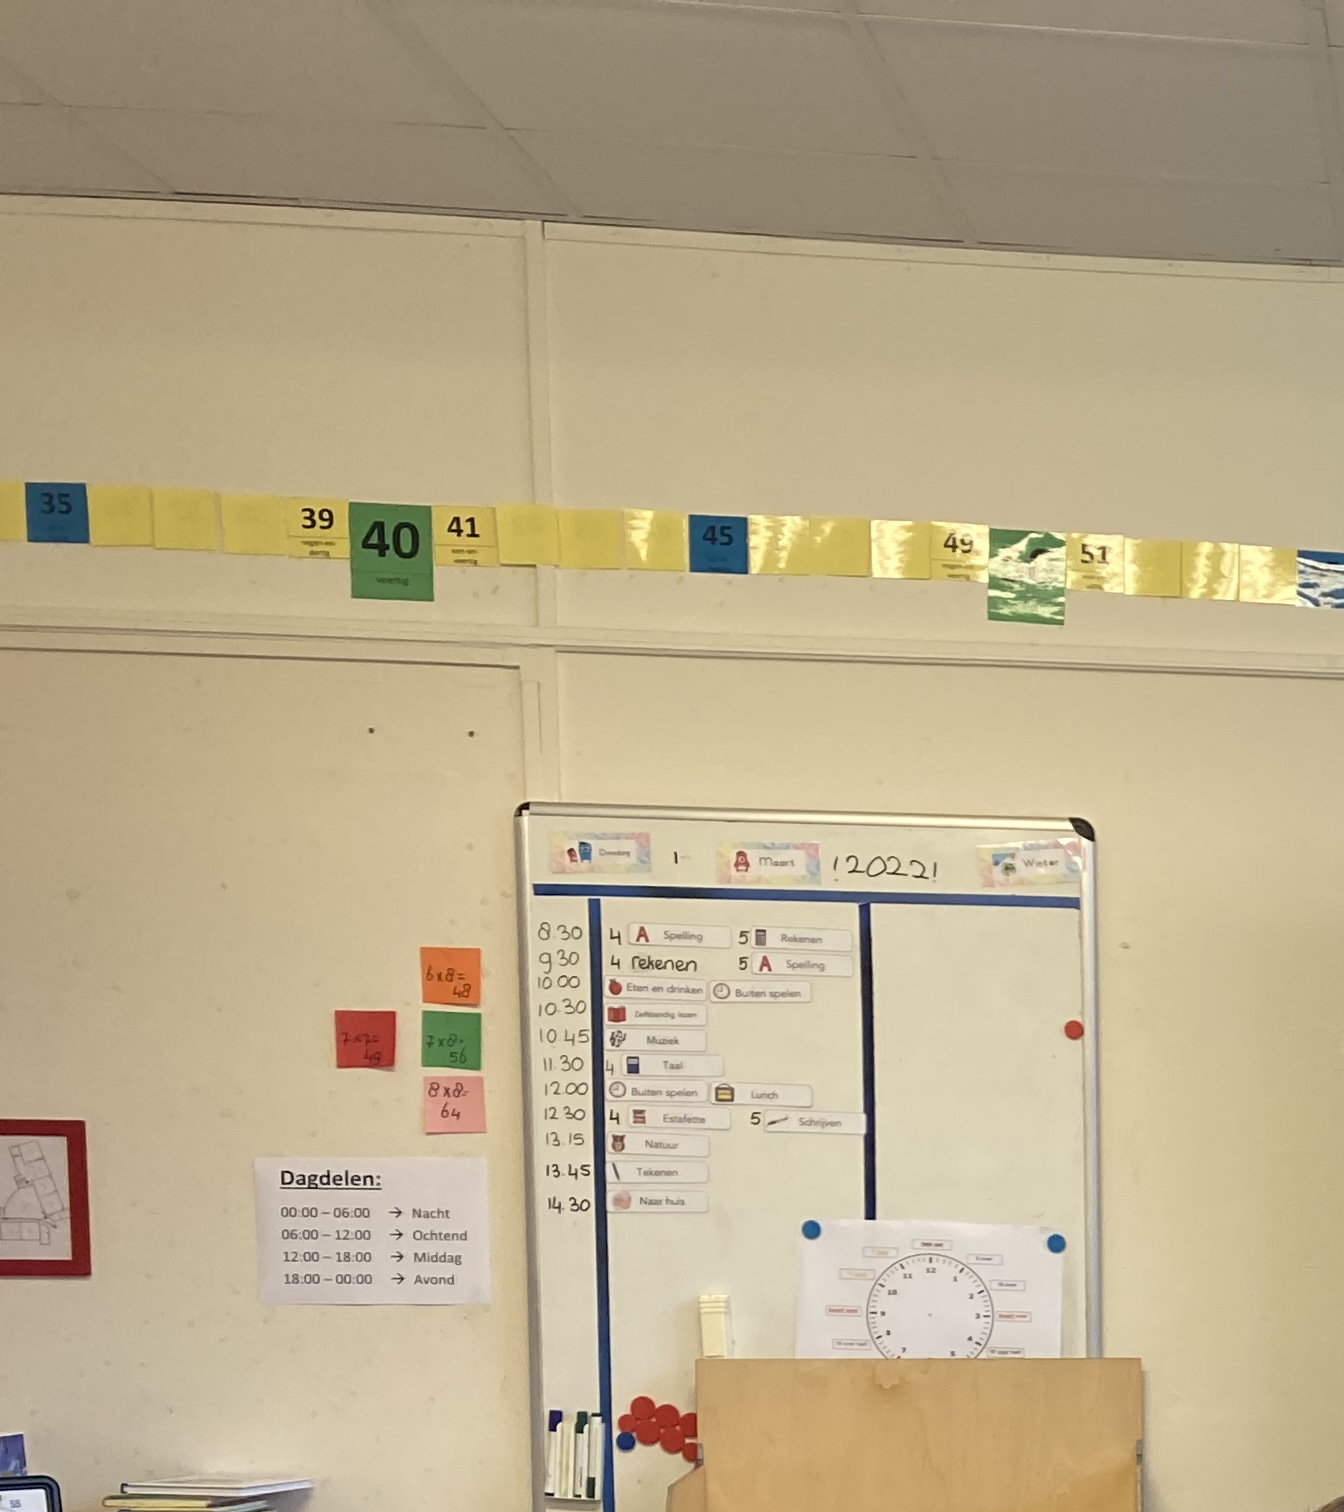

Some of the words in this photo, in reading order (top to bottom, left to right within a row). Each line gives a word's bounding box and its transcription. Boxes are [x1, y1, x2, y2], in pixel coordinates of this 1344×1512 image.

[40, 493, 72, 515] 35
[302, 508, 333, 529] 39
[447, 517, 480, 538] 41
[362, 521, 419, 559] 40
[703, 525, 733, 546] 45
[943, 533, 973, 554] 49
[1081, 544, 1109, 564] 51
[759, 857, 795, 867] Maart
[1022, 859, 1059, 867] Winter
[610, 928, 621, 945] 4
[664, 931, 703, 943] Spelling
[737, 930, 750, 946] 5
[780, 933, 823, 944] Rekenen
[610, 955, 621, 970] 4
[632, 956, 697, 972] rekenen
[738, 956, 749, 971] 5
[786, 960, 825, 972] Spelling
[452, 983, 471, 998] 48
[627, 983, 648, 992] Eten
[666, 984, 704, 995] drinken
[734, 988, 767, 998] Buiten
[769, 990, 801, 999] spelen
[647, 1036, 679, 1045] Muziek
[450, 1047, 467, 1064] 56
[663, 1060, 683, 1070] Taal
[631, 1087, 662, 1096] Buiten
[751, 1090, 779, 1099] Lunch
[441, 1102, 460, 1120] 64
[609, 1110, 620, 1125] 4
[663, 1114, 706, 1124] Estafette
[750, 1112, 761, 1125] 5
[798, 1117, 842, 1129] Schrijven
[645, 1140, 678, 1149] Natuur
[637, 1168, 678, 1176] Tekenen
[280, 1170, 382, 1190] Dagdelen:
[640, 1197, 662, 1205] Naar
[665, 1196, 686, 1207] huis
[281, 1207, 318, 1218] 00:00
[333, 1208, 370, 1218] 06:00
[412, 1208, 450, 1219] Nacht
[282, 1229, 318, 1240] 06:00
[335, 1230, 371, 1240] 12:00
[413, 1230, 467, 1241] Ochtend
[284, 1251, 319, 1262] 12:00
[336, 1252, 372, 1262] 18:00
[414, 1252, 462, 1265] Middag
[284, 1274, 320, 1284] 18:00
[336, 1274, 372, 1284] 00:00
[414, 1274, 454, 1285] Avond
